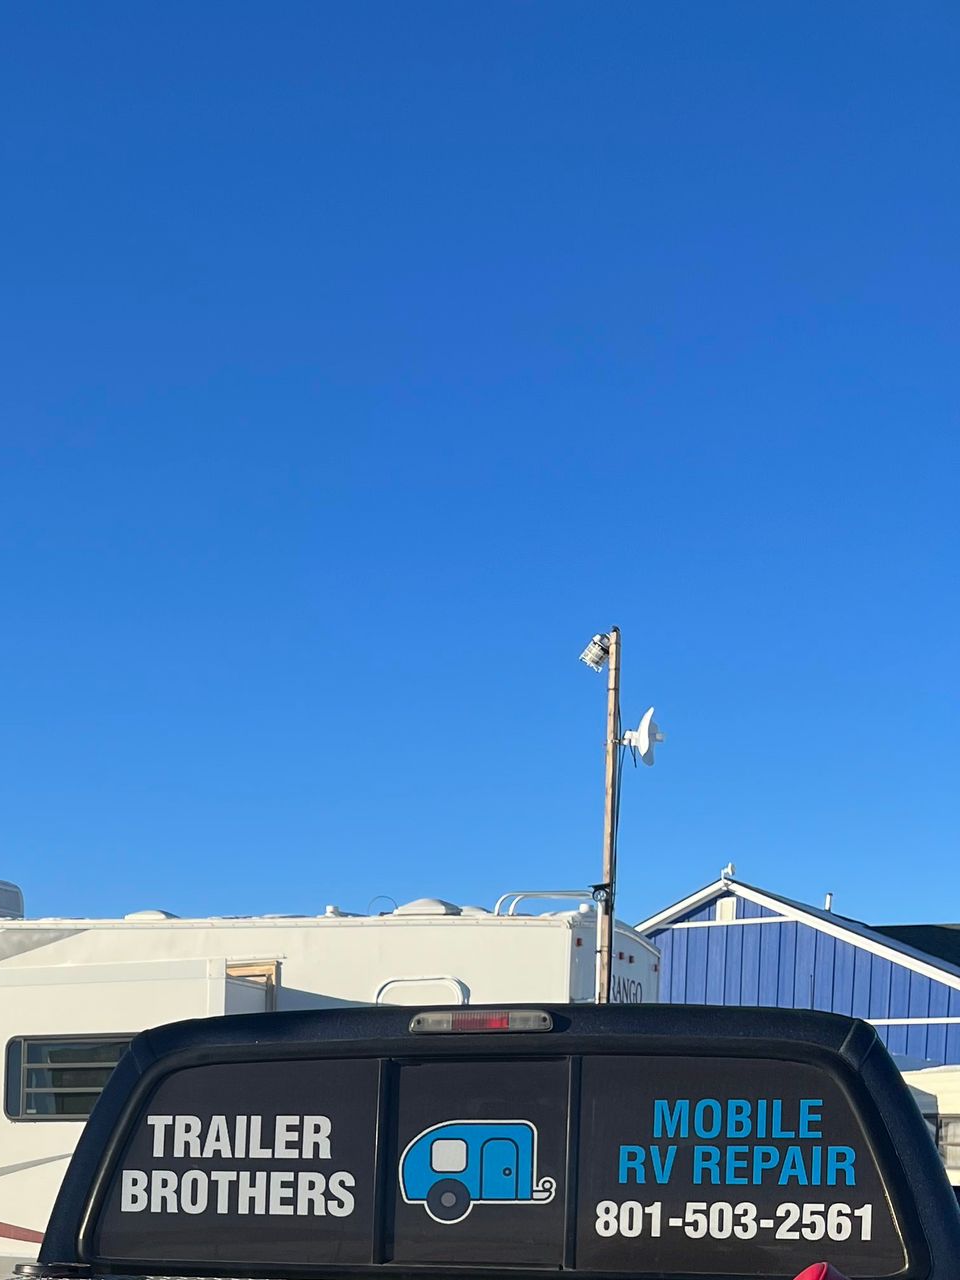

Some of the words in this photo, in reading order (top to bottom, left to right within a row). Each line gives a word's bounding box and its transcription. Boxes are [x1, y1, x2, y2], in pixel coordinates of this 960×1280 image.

[147, 1115, 332, 1160] TRAILER
[652, 1098, 824, 1139] MOBILE
[618, 1145, 678, 1185] RV
[693, 1145, 857, 1186] REPAIR
[121, 1169, 356, 1218] BROTHERS
[595, 1200, 873, 1242] 801-503-2561
